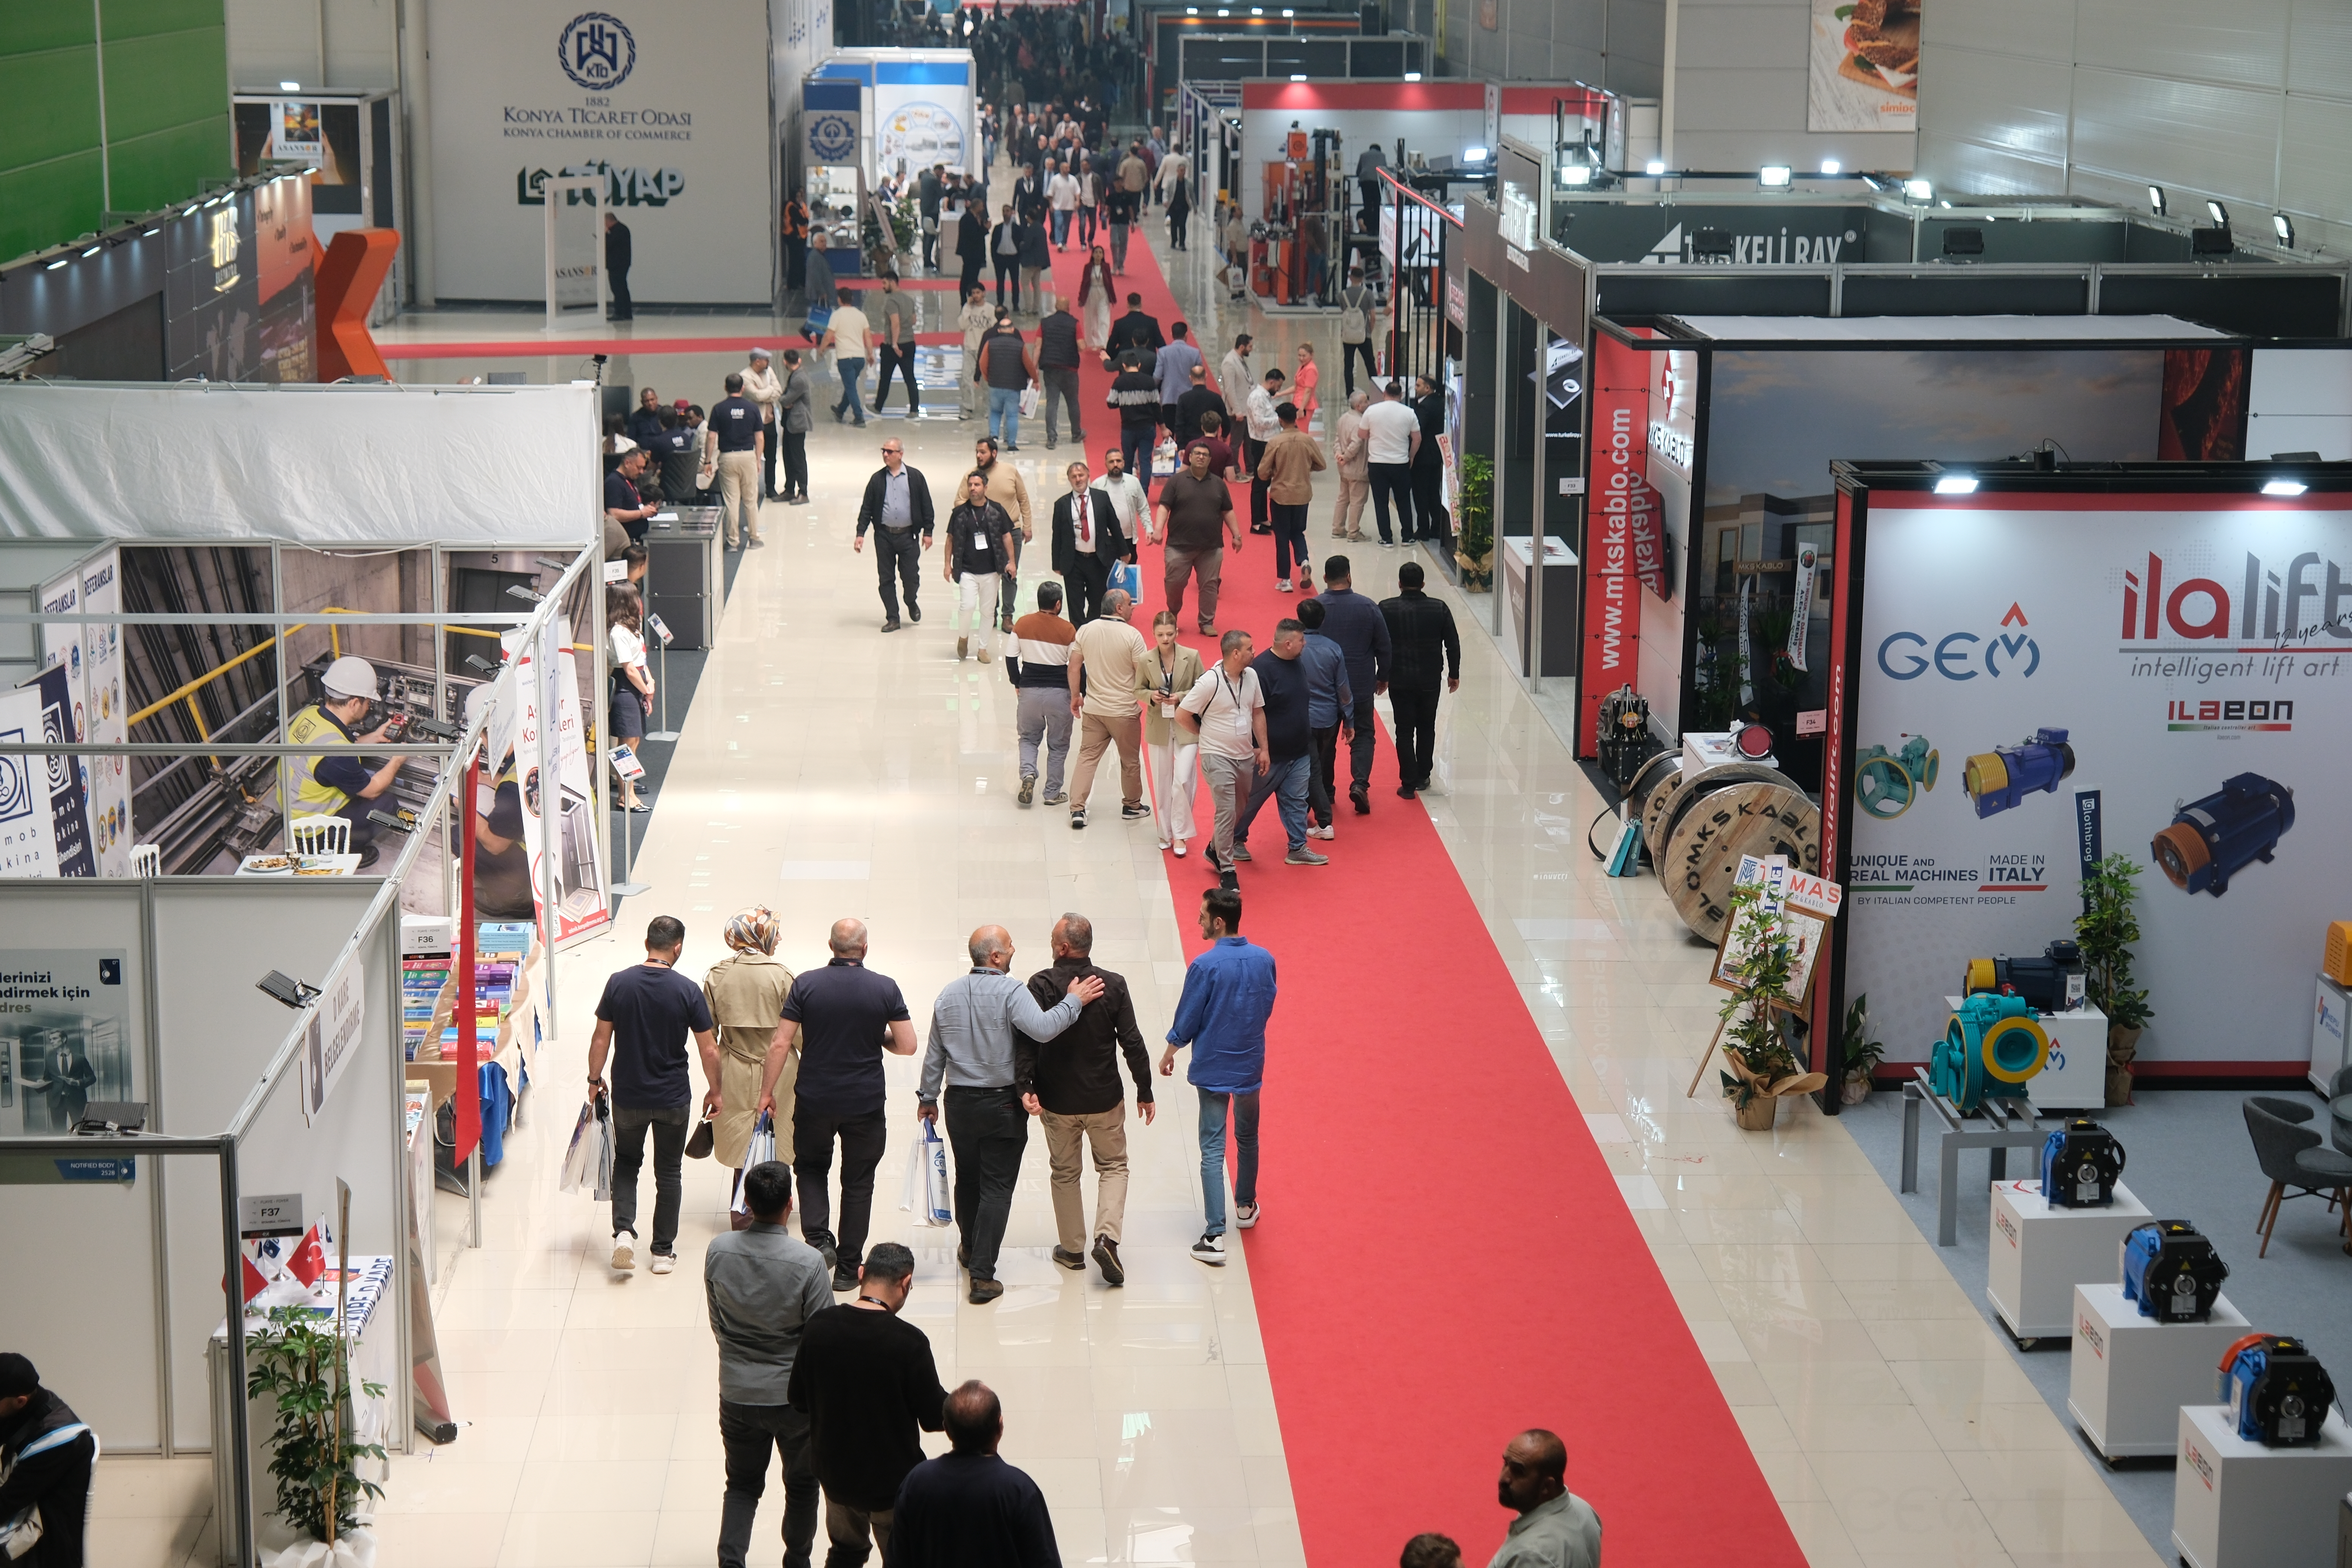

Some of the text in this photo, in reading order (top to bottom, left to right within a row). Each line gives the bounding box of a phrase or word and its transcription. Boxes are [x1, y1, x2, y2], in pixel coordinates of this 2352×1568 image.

[585, 97, 610, 107] 1882
[504, 106, 563, 123] KONYA
[642, 108, 692, 126] ODASI
[504, 128, 692, 141] KONYA CHAMBER OF COMMERCE
[1795, 236, 1842, 263] RAY
[1602, 408, 1631, 670] www.mkskablo.com
[491, 553, 499, 564] 5
[84, 564, 113, 597] REFERANSLAR
[1877, 632, 2040, 680] GEM
[2131, 655, 2340, 684] intelligent lift art
[1686, 808, 1731, 867] MKS
[1738, 802, 1818, 863] KABLO
[2084, 810, 2093, 862] lothbrog
[1850, 855, 1934, 868] UNIQUE AND
[1989, 854, 2045, 865] MADE IN
[1850, 870, 1979, 881] REAL MACHINES
[1989, 867, 2045, 882] ITALY
[1977, 896, 2016, 905] PEOPLE
[63, 986, 90, 1001] için
[338, 975, 349, 1016] KARE
[325, 999, 360, 1079] BELGELENDİRME
[261, 1208, 280, 1217] F37
